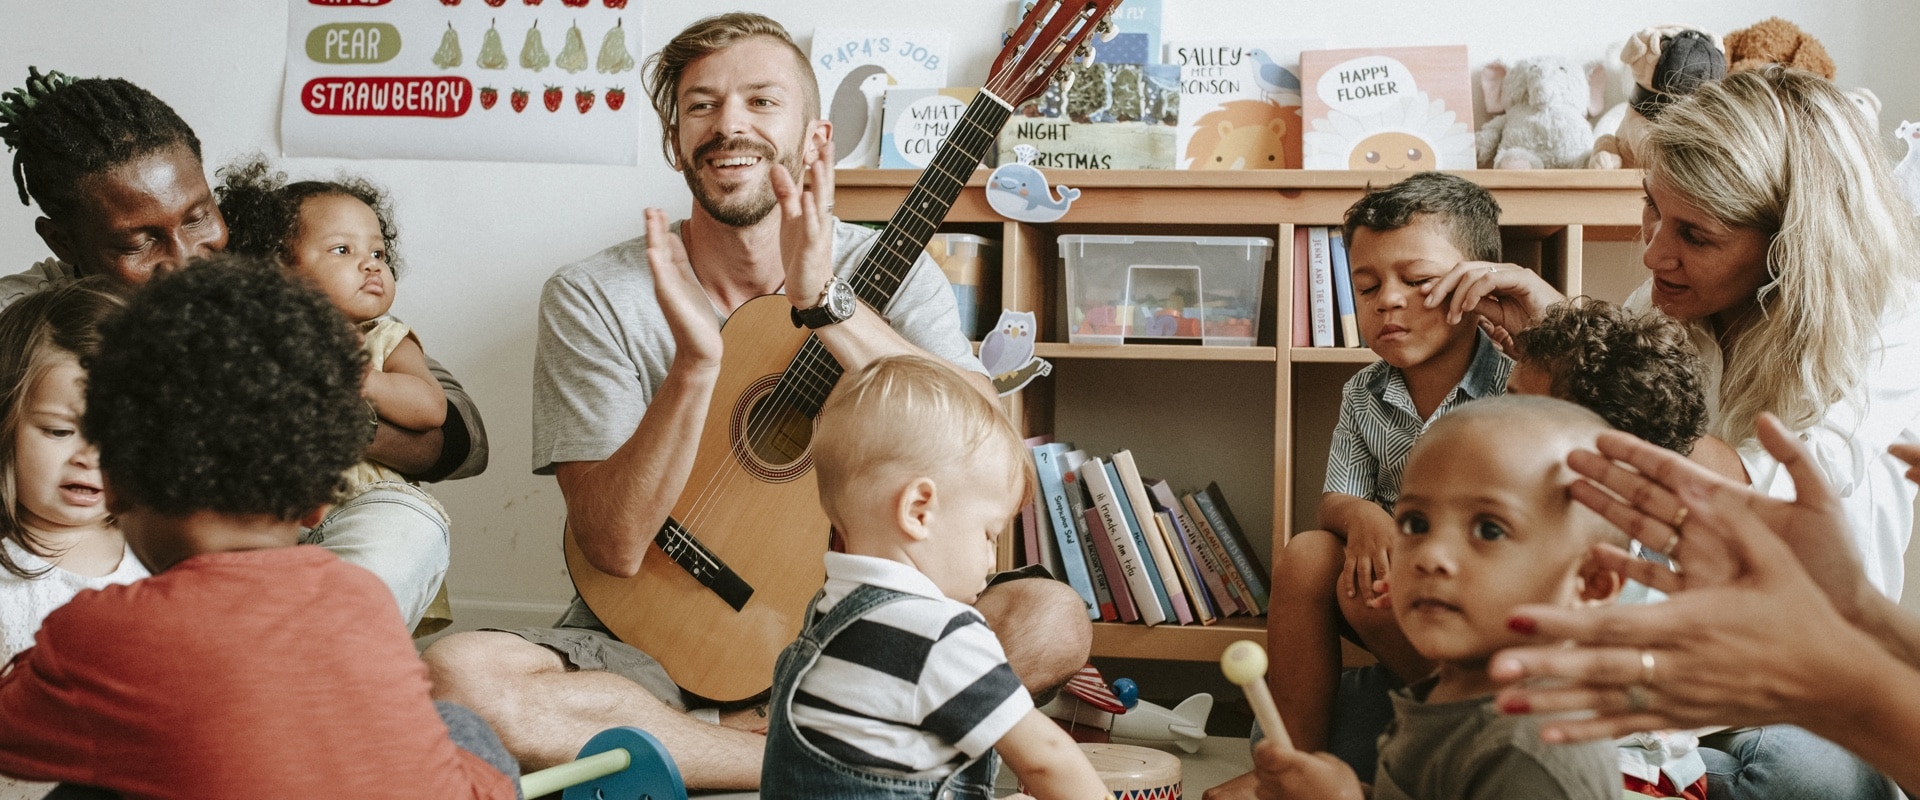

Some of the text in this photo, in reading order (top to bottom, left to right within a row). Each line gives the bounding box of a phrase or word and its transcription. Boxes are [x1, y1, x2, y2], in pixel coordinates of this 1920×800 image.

[1126, 6, 1147, 20] FLY
[325, 28, 381, 60] PEAR
[819, 37, 940, 71] PAPA'S JOB
[1178, 46, 1242, 66] SALLEY
[1191, 67, 1223, 77] MEET
[1340, 65, 1389, 84] HAPPY
[1180, 79, 1240, 94] KONSON
[1337, 81, 1399, 102] FLOWER
[310, 80, 464, 113] STRAWBERRY
[911, 104, 962, 120] WHAT
[924, 121, 950, 137] MY
[1017, 122, 1070, 141] NIGHT
[1015, 152, 1112, 170] RISTMAS
[1312, 239, 1327, 335] JENNY AND THE HORSE
[1040, 452, 1048, 463] ?
[1178, 514, 1196, 545] Friendly
[1195, 545, 1214, 573] Monster
[1117, 544, 1126, 557] am
[1123, 558, 1136, 577] tofu
[1203, 528, 1220, 550] PLANT
[1219, 552, 1233, 570] LIFE
[1230, 571, 1249, 592] CYCLE
